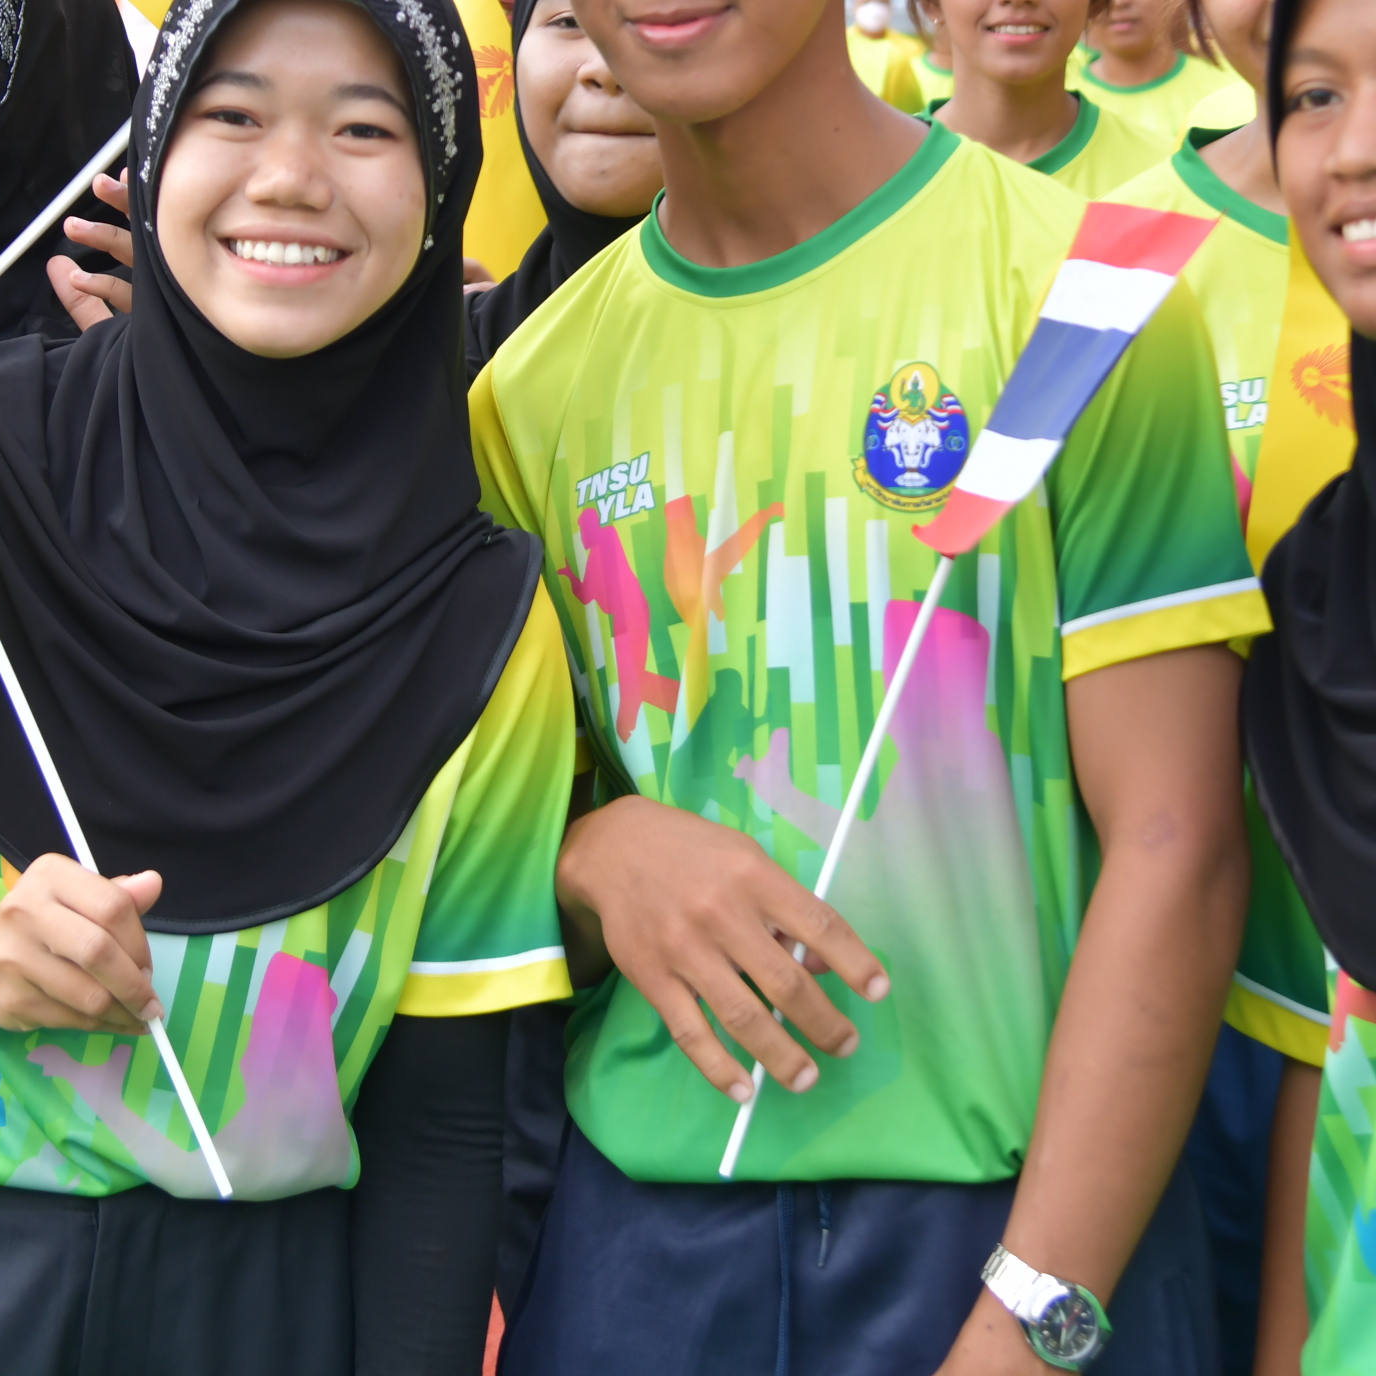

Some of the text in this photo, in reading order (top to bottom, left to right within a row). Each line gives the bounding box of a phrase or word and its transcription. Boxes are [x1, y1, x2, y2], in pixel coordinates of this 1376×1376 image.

[1219, 376, 1267, 407] SU
[1225, 401, 1269, 430] LA
[575, 450, 650, 509] TNSU
[596, 480, 656, 526] YLA
